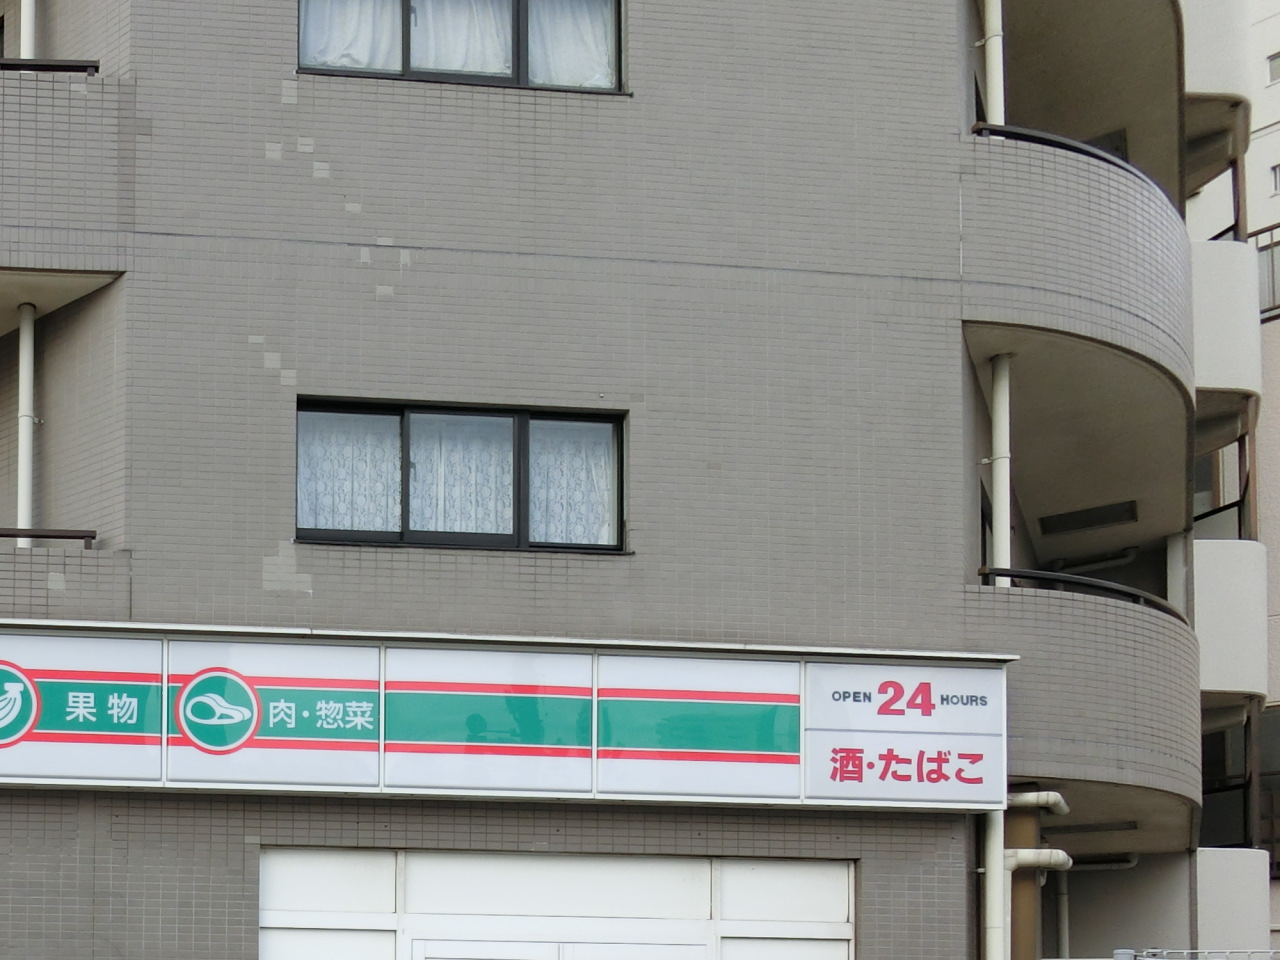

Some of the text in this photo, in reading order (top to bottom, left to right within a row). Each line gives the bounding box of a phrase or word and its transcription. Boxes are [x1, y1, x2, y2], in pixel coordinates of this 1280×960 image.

[65, 691, 138, 725] 果物
[269, 699, 374, 731] 肉・惣菜
[831, 680, 988, 717] OPEN 24 HOURS
[830, 747, 984, 785] 酒・たばこ
